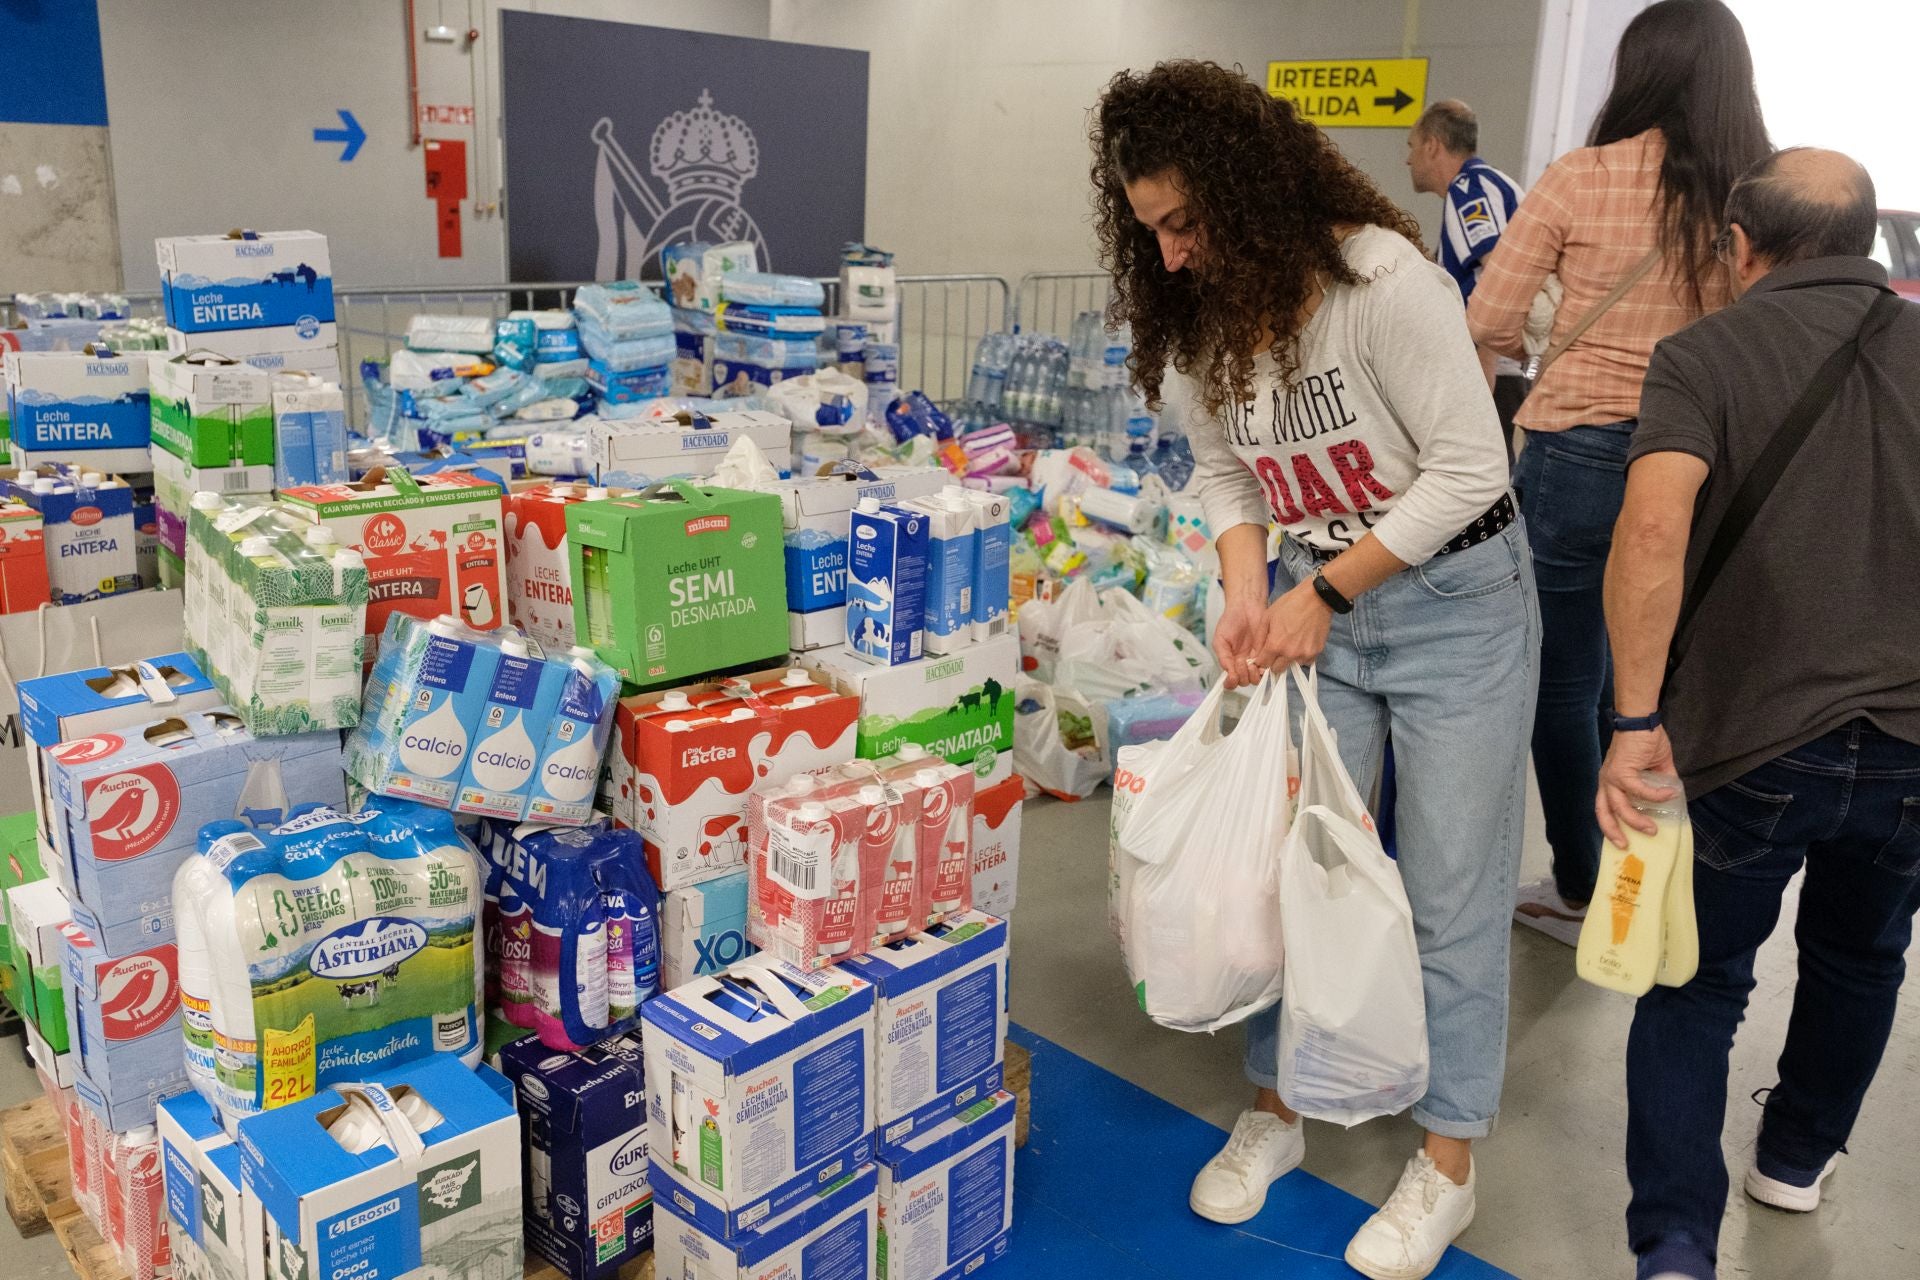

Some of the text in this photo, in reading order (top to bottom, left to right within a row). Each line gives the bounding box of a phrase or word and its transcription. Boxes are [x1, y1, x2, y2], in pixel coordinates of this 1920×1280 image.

[1275, 67, 1377, 87] IRTEERA
[1292, 96, 1361, 116] ALIDA
[191, 292, 223, 306] Leche
[193, 302, 263, 324] ENTERA
[1271, 366, 1357, 445] MORE
[35, 410, 70, 423] Leche
[36, 422, 113, 442] ENTERA
[682, 434, 729, 449] HACENDADO
[857, 484, 896, 500] HACENDADO
[1250, 439, 1396, 525] OAR
[340, 502, 361, 513] 100%
[361, 500, 384, 511] PAPEL
[383, 497, 420, 509] RECICLADO
[425, 493, 456, 504] ENVASES
[455, 488, 499, 500] SOSTENIBLES
[75, 528, 101, 538] LECHE
[687, 517, 728, 533] milsani
[61, 538, 118, 557] ENTERA
[368, 534, 404, 549] Classic
[856, 541, 876, 552] Leche
[466, 559, 489, 568] ENTERA
[667, 556, 722, 575] Leche UHT
[812, 552, 843, 570] Leche
[368, 567, 413, 581] LECHE UHT
[534, 566, 559, 582] LECHE
[812, 569, 847, 596] ENT
[368, 582, 422, 600] NTERA
[525, 579, 573, 606] ENTERA
[669, 569, 735, 607] SEMI
[671, 596, 756, 628] DESNATADA
[925, 661, 965, 680] HACENDADO
[494, 691, 517, 702] Entera
[565, 704, 589, 719] Entera
[404, 734, 463, 758] calcio
[875, 735, 908, 755] Leche
[924, 721, 1003, 757] ESNATADA
[477, 749, 531, 772] calcio
[547, 762, 596, 781] calcio
[100, 777, 142, 794] Auchan
[974, 842, 1002, 861] LECHE
[427, 863, 444, 871] FILM
[939, 857, 965, 874] LECHE
[974, 853, 1007, 875] NTERA
[371, 876, 408, 902] 100%
[429, 870, 462, 891] 50%
[885, 878, 912, 895] LECHE
[601, 895, 626, 908] EVA
[825, 897, 856, 915] LECHE
[301, 905, 346, 923] EMISIONES
[333, 928, 414, 951] CENTRAL LECHERA
[315, 936, 418, 973] ASTURIANA
[112, 959, 153, 978] Auchan
[891, 1008, 928, 1027] LECHE UHT
[895, 1000, 924, 1018] Auchan
[887, 1016, 932, 1045] SEMIDESNATADA
[271, 1036, 311, 1056] AHORRO
[318, 1031, 421, 1074] semidesnatada
[321, 1043, 345, 1060] Leche
[271, 1047, 311, 1068] FAMILIAR
[571, 1064, 628, 1094] Leche UHT
[746, 1076, 778, 1096] Auchan
[741, 1082, 783, 1109] LECHE UHT
[736, 1090, 789, 1124] SEMIDESNATADA
[614, 1143, 648, 1171] GURE
[174, 1156, 194, 1185] EROSKI
[435, 1170, 463, 1186] EUSKADI
[171, 1188, 185, 1210] Osoa
[436, 1184, 462, 1198] VASCO
[909, 1180, 936, 1199] Auchan
[901, 1193, 944, 1226] SEMIDESNATADA
[905, 1189, 940, 1211] LECHE UHT
[172, 1199, 189, 1226] Entera
[350, 1201, 398, 1228] EROSKI
[632, 1220, 653, 1238] 6x1
[330, 1235, 375, 1258] UHT esnea
[331, 1243, 376, 1267] Leche UHT
[332, 1259, 369, 1280] Osoa
[758, 1263, 788, 1280] Auchan
